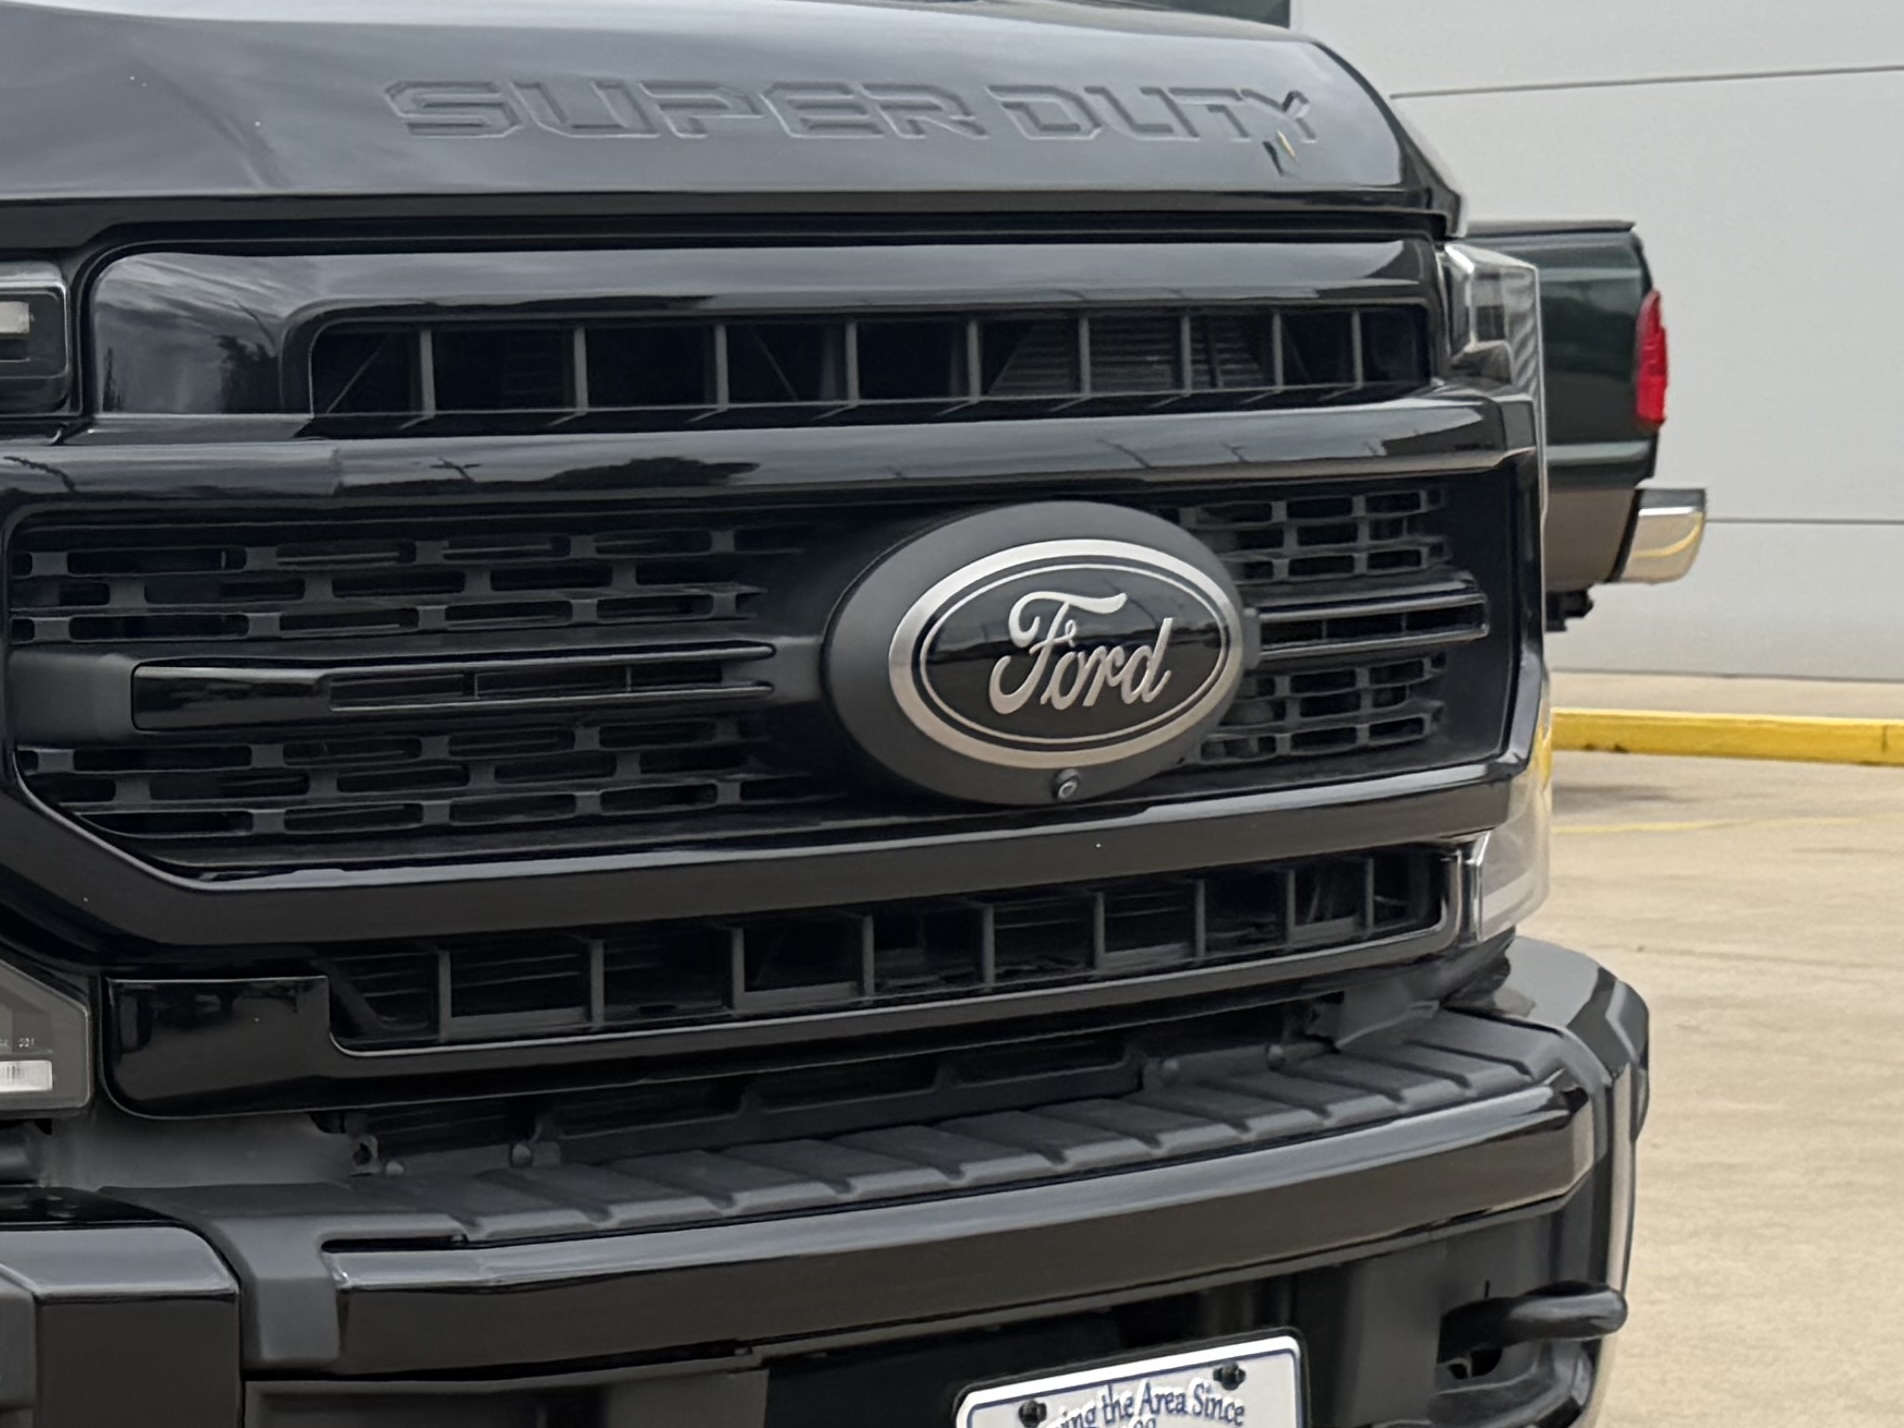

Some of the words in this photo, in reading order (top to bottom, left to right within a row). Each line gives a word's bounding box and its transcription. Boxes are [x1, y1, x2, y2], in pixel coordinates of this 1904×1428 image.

[385, 79, 989, 140] SUPER
[984, 84, 1319, 144] DUTY
[989, 591, 1173, 714] Ford
[1102, 1383, 1134, 1426] the
[1138, 1380, 1186, 1418] Area
[1192, 1382, 1245, 1428] Since
